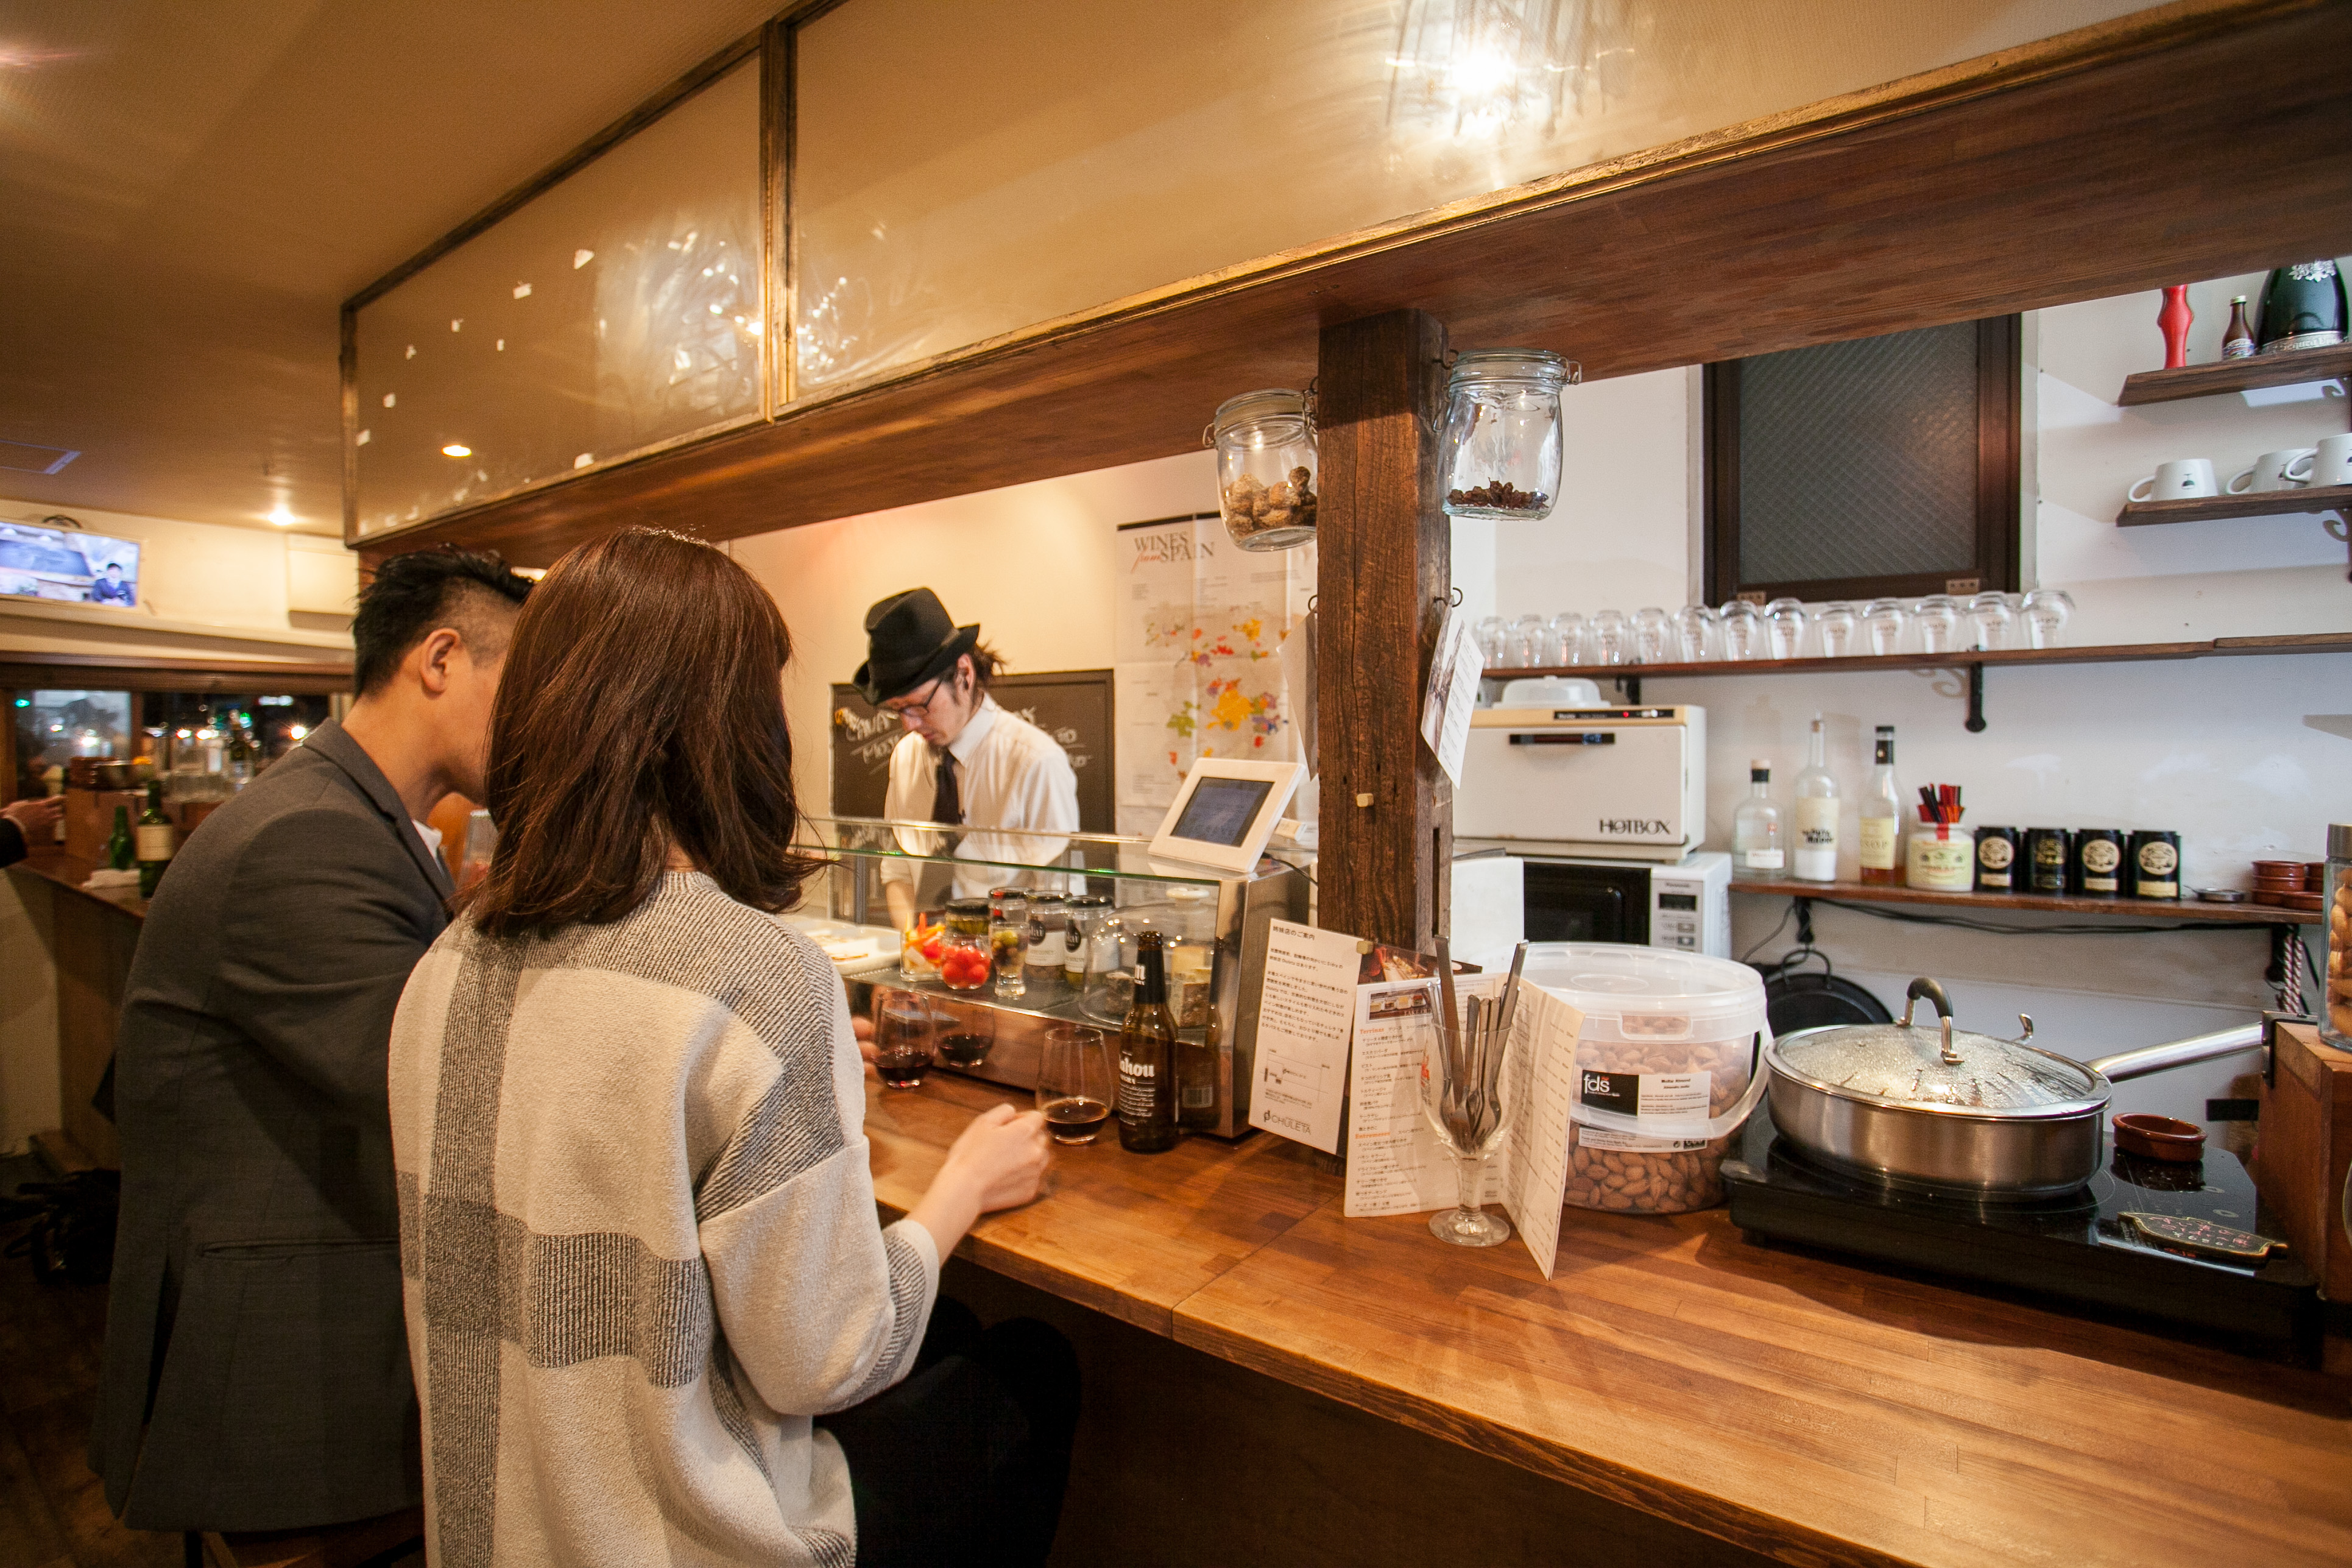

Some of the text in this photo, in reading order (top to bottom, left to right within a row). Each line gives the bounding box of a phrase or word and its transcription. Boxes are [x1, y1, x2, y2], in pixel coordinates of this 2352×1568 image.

[1134, 532, 1188, 551] WINES
[1131, 546, 1162, 573] from
[1599, 819, 1670, 835] HOTBOX
[1273, 925, 1315, 941] 姉妹店のご案内
[1359, 1026, 1384, 1034] Terrinas
[1119, 1056, 1155, 1078] ahou
[1583, 1073, 1610, 1094] fds
[1271, 1114, 1312, 1135] CHULETA
